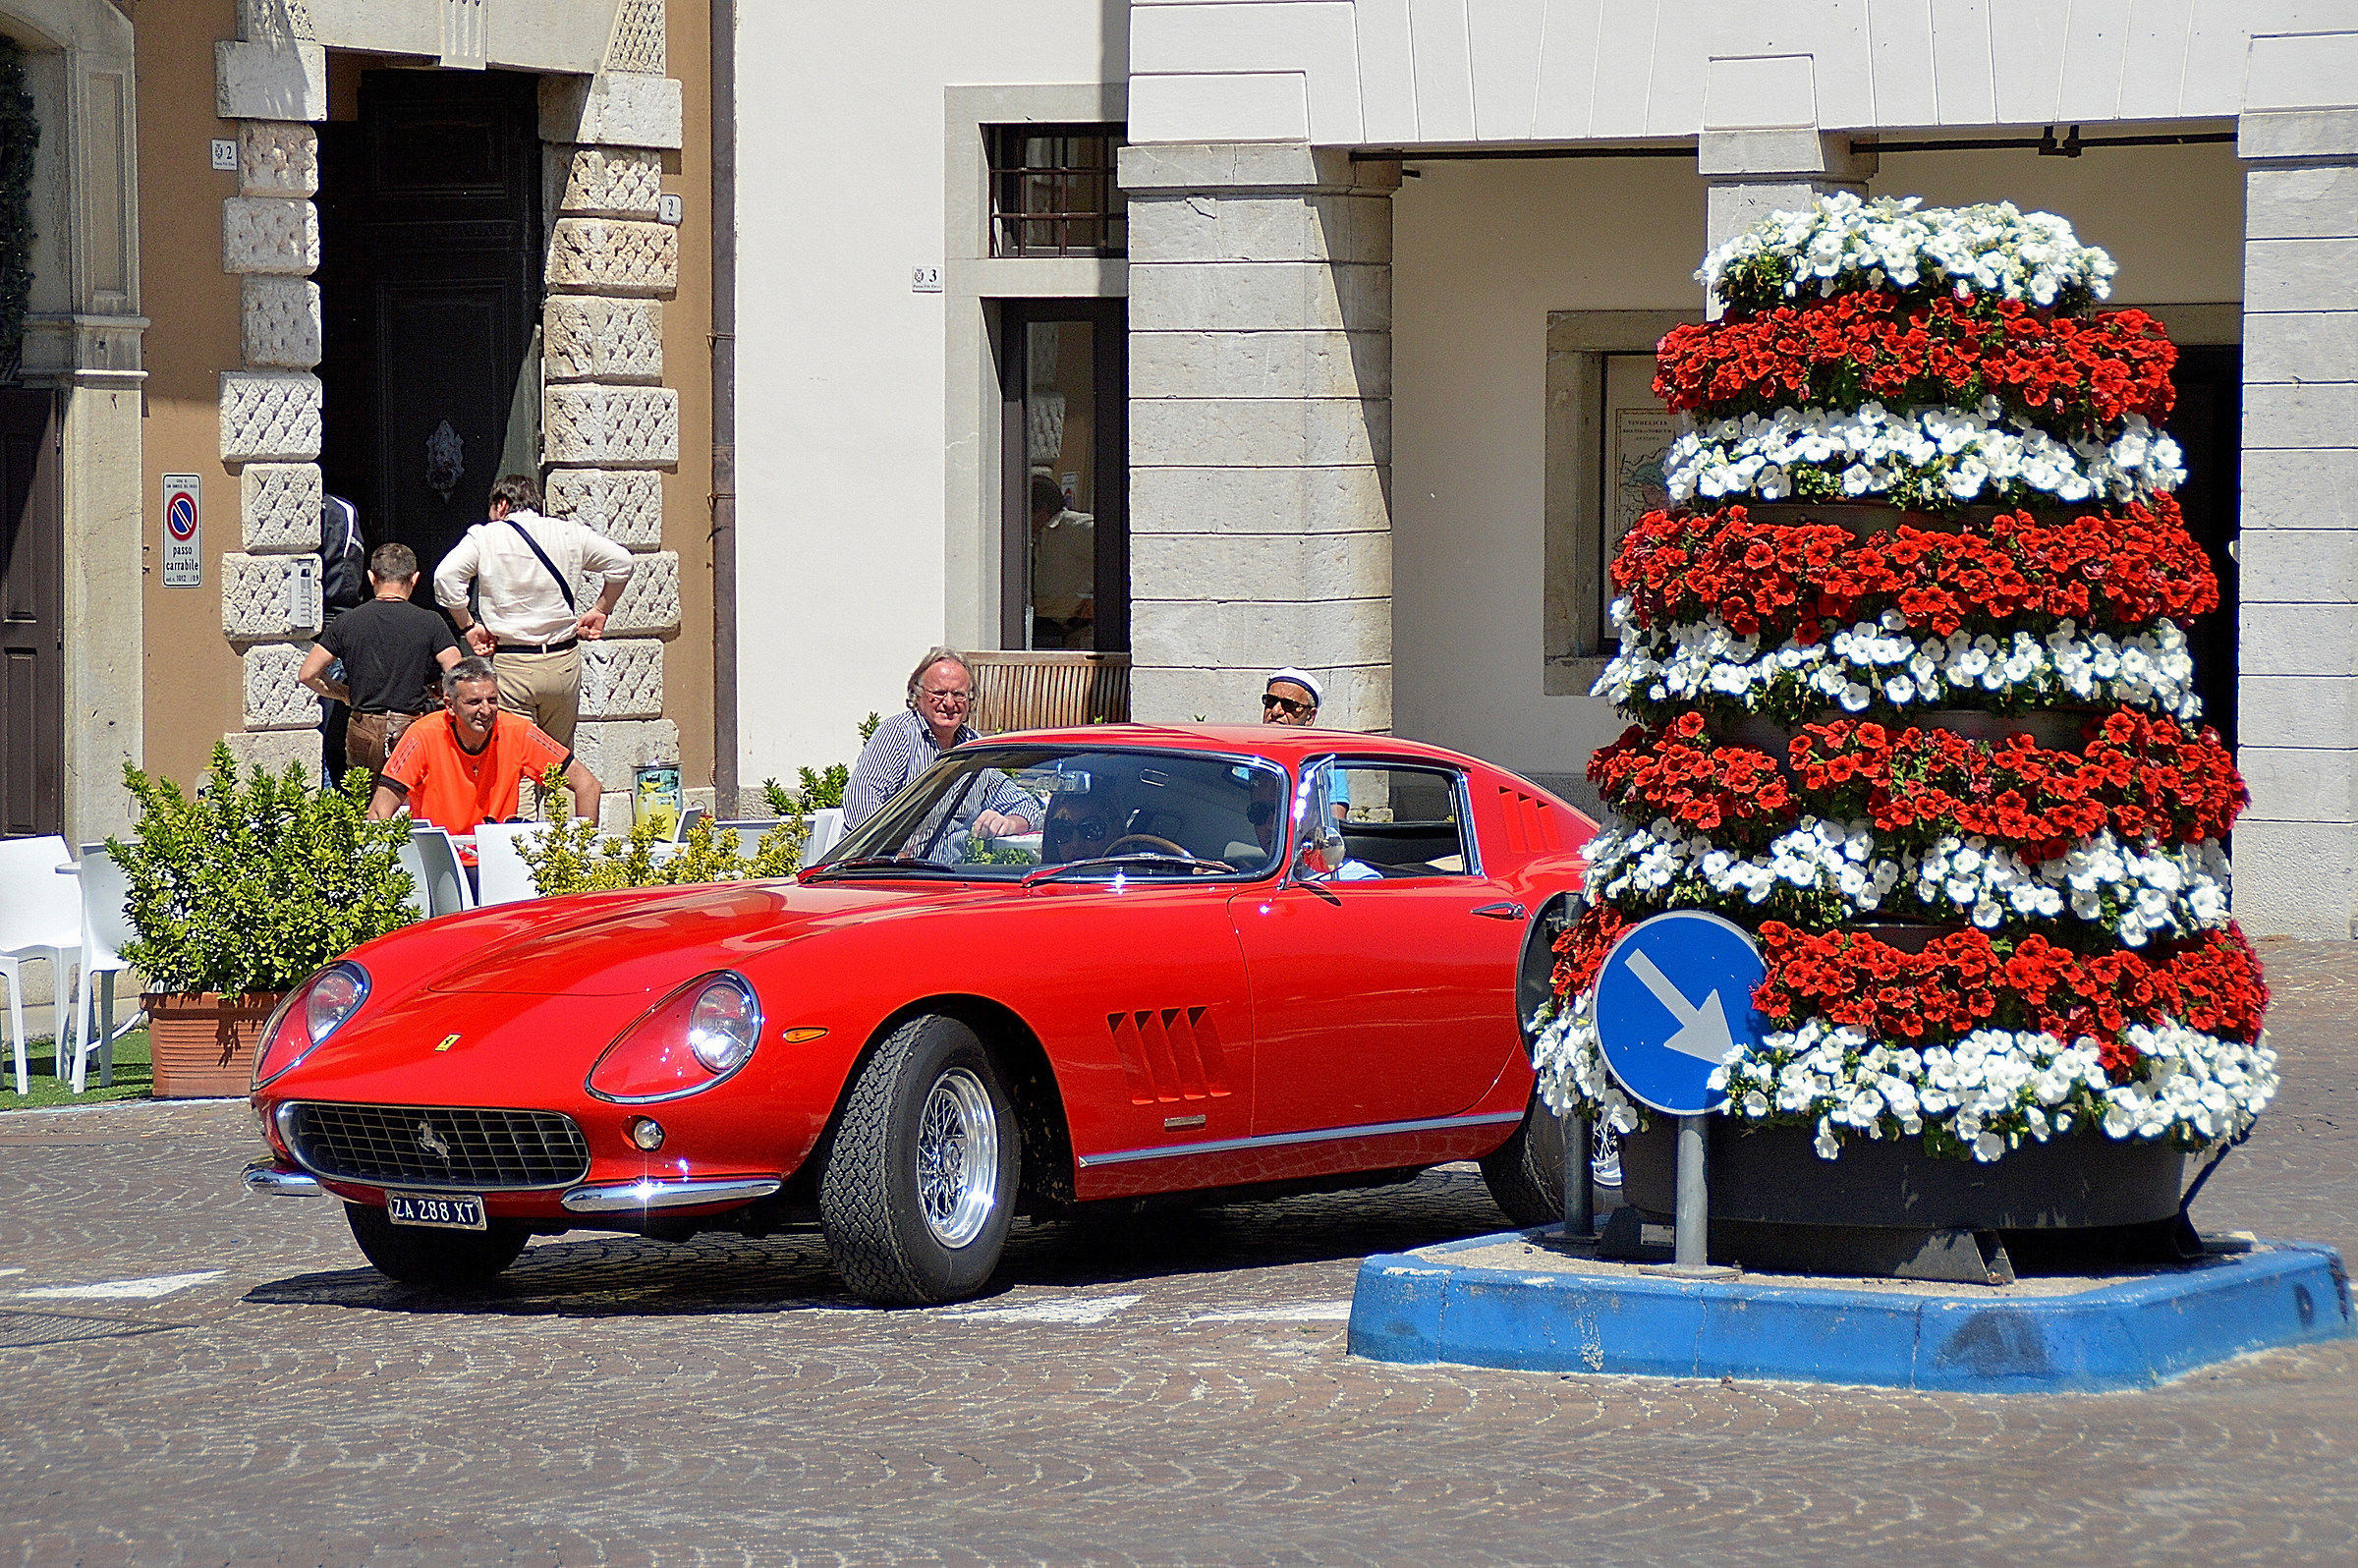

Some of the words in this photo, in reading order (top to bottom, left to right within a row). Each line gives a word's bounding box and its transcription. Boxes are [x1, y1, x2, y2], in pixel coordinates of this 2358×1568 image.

[226, 144, 233, 160] 2
[668, 198, 674, 217] 2
[928, 268, 937, 283] 3
[173, 546, 193, 558] passo
[166, 559, 198, 571] carrabile
[393, 1199, 414, 1218] ZA
[418, 1201, 449, 1221] 288
[454, 1203, 474, 1222] XT
